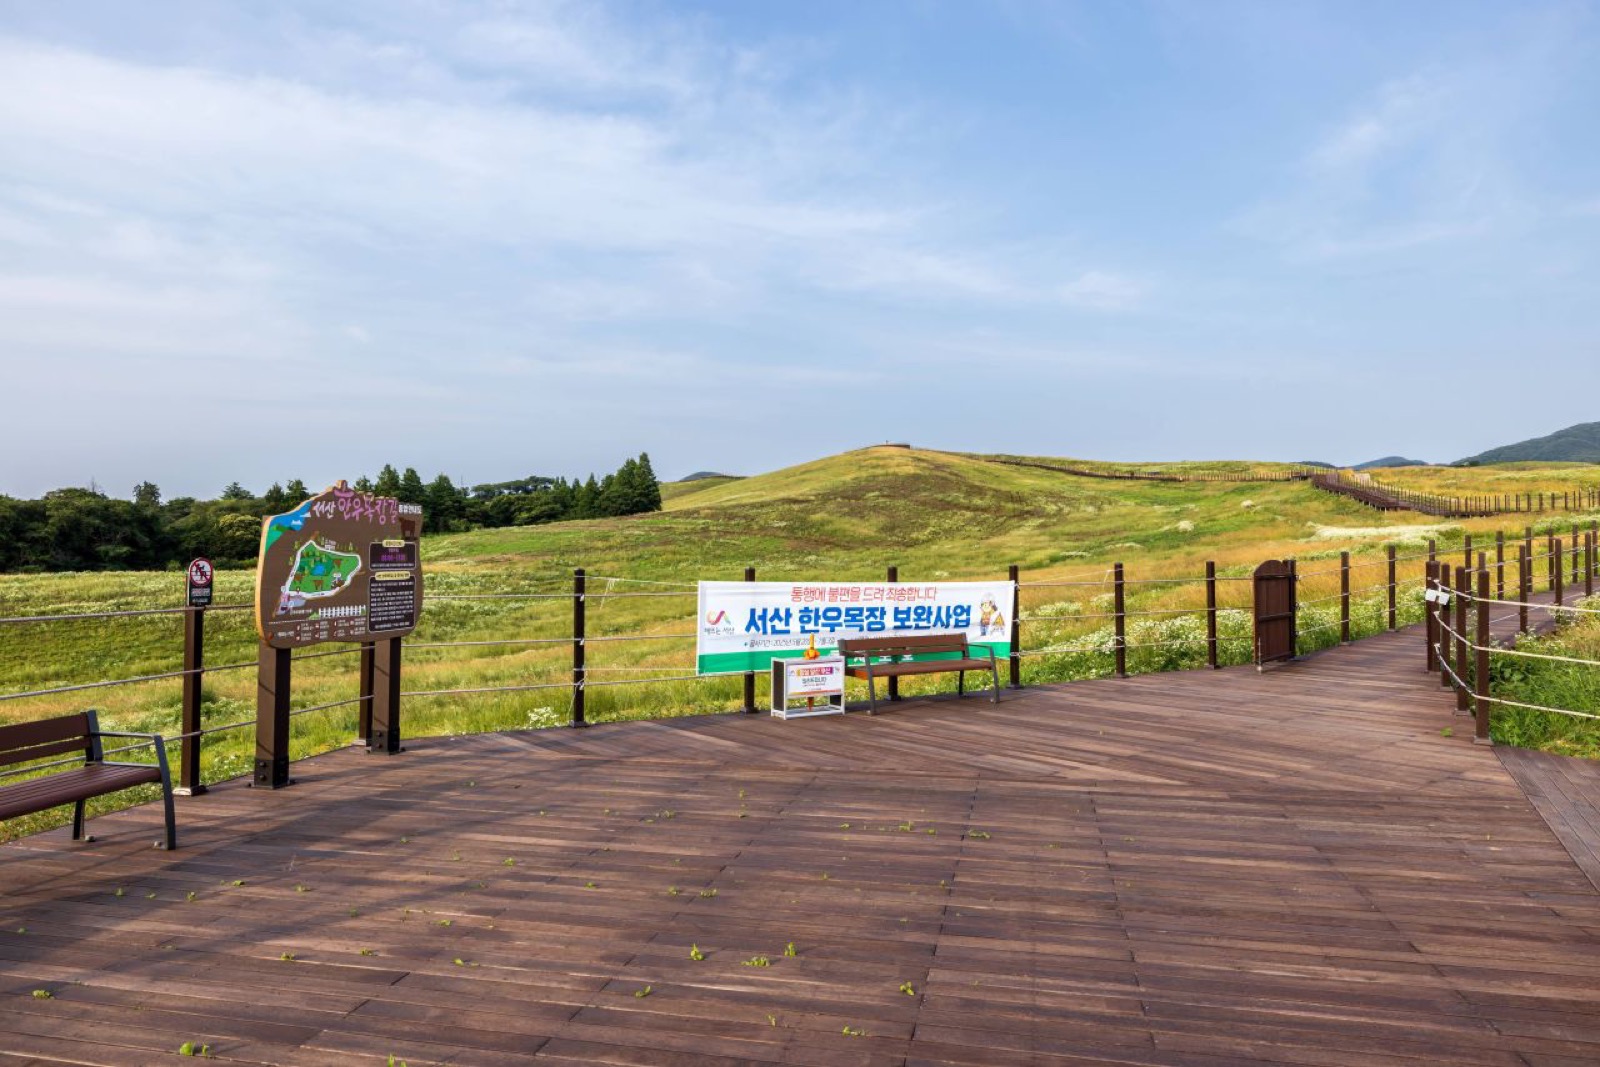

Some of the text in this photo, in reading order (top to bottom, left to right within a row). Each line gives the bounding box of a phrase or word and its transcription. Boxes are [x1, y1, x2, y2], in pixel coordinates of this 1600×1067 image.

[313, 501, 336, 519] 서산
[334, 490, 398, 525] 한우목장길
[791, 585, 937, 602] 통행에 불편을 드려 죄송합니다
[744, 604, 972, 635] 서산 한우목장 보완사업
